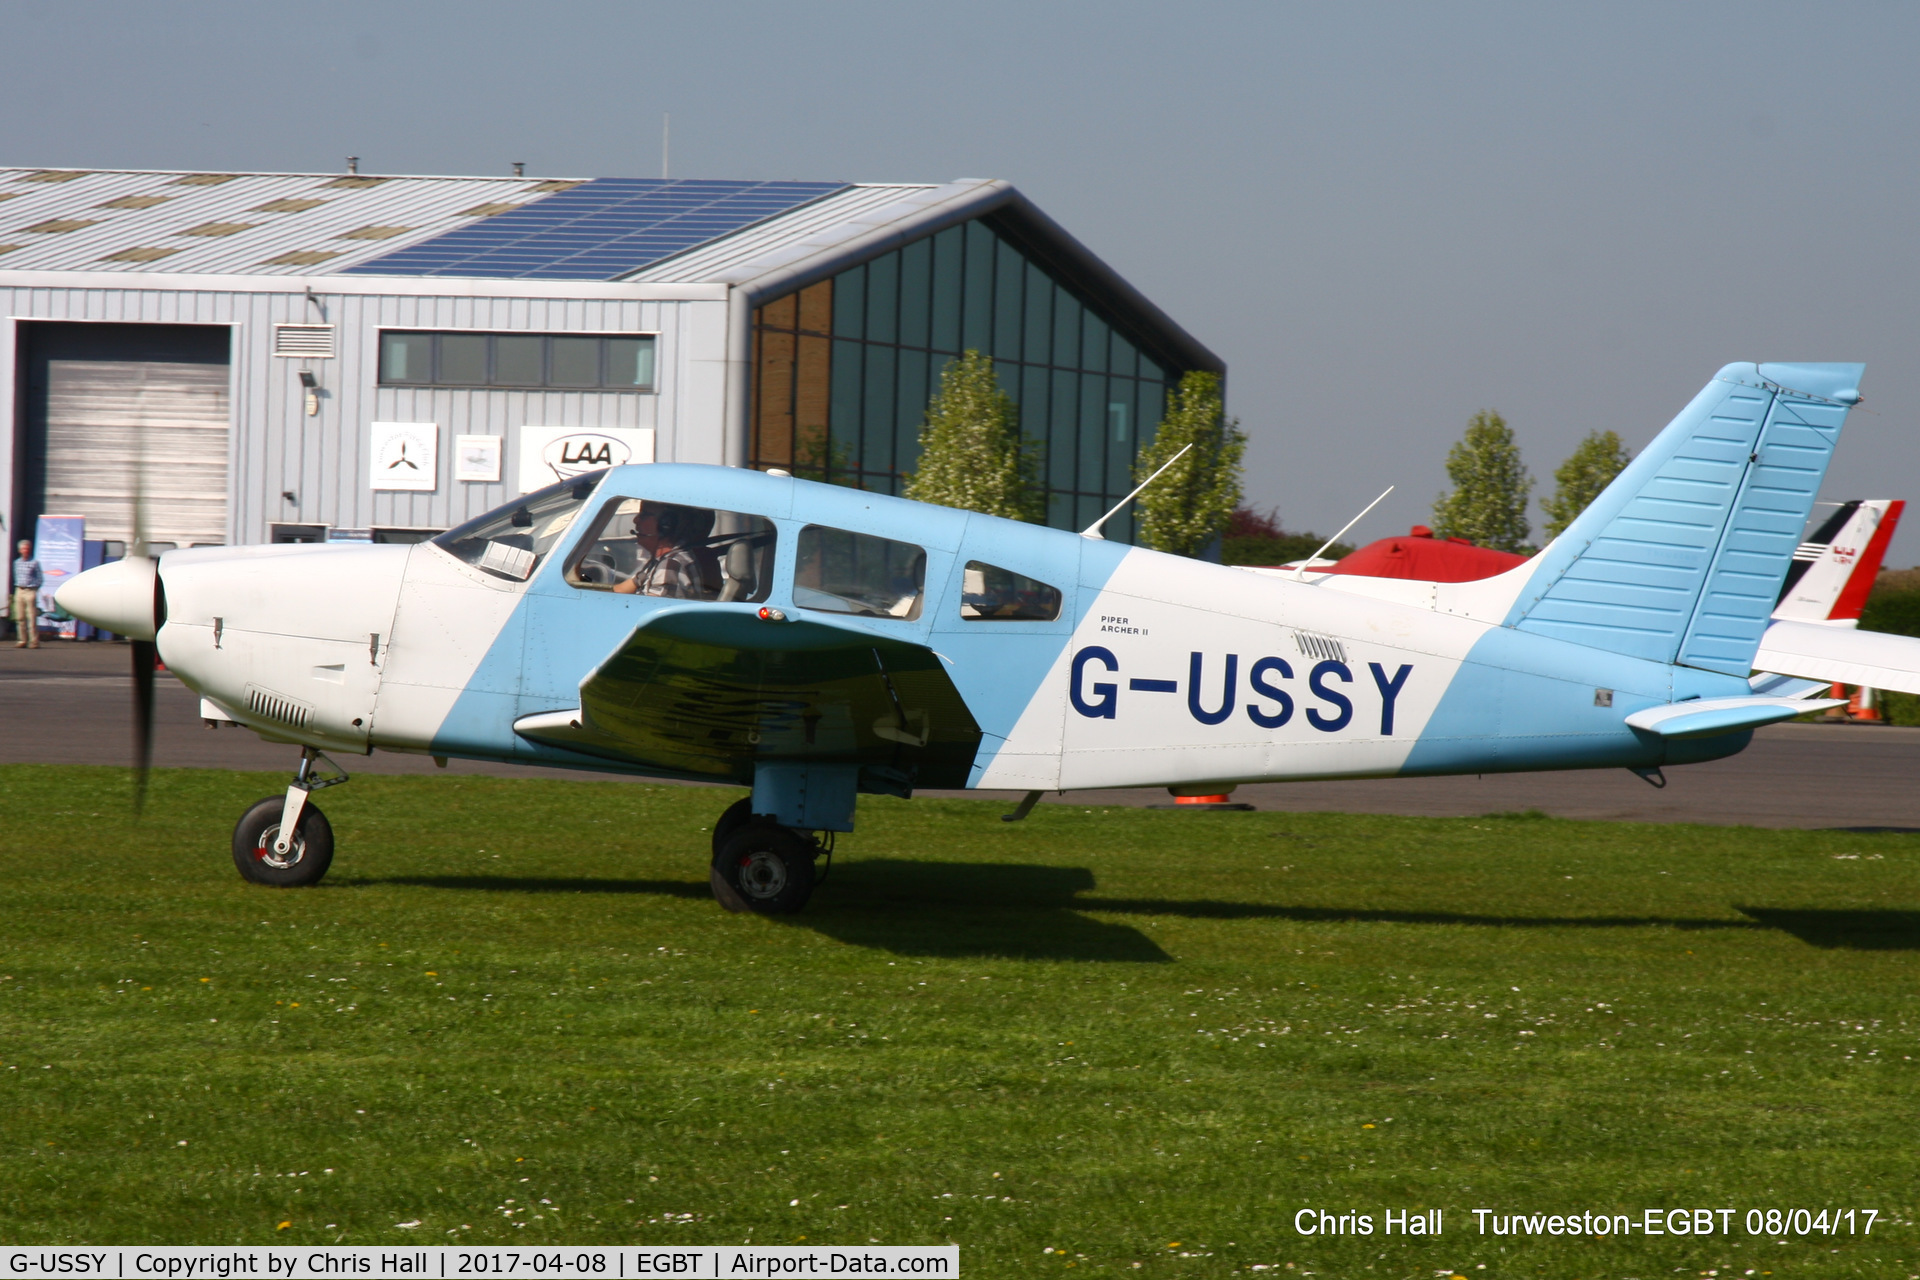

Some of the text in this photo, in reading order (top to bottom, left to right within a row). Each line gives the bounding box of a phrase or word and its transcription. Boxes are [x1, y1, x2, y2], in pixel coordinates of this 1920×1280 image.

[561, 442, 612, 465] LAA
[1101, 615, 1129, 625] PIPER
[1101, 625, 1149, 636] ARCHER II
[1070, 645, 1413, 735] G-USSY
